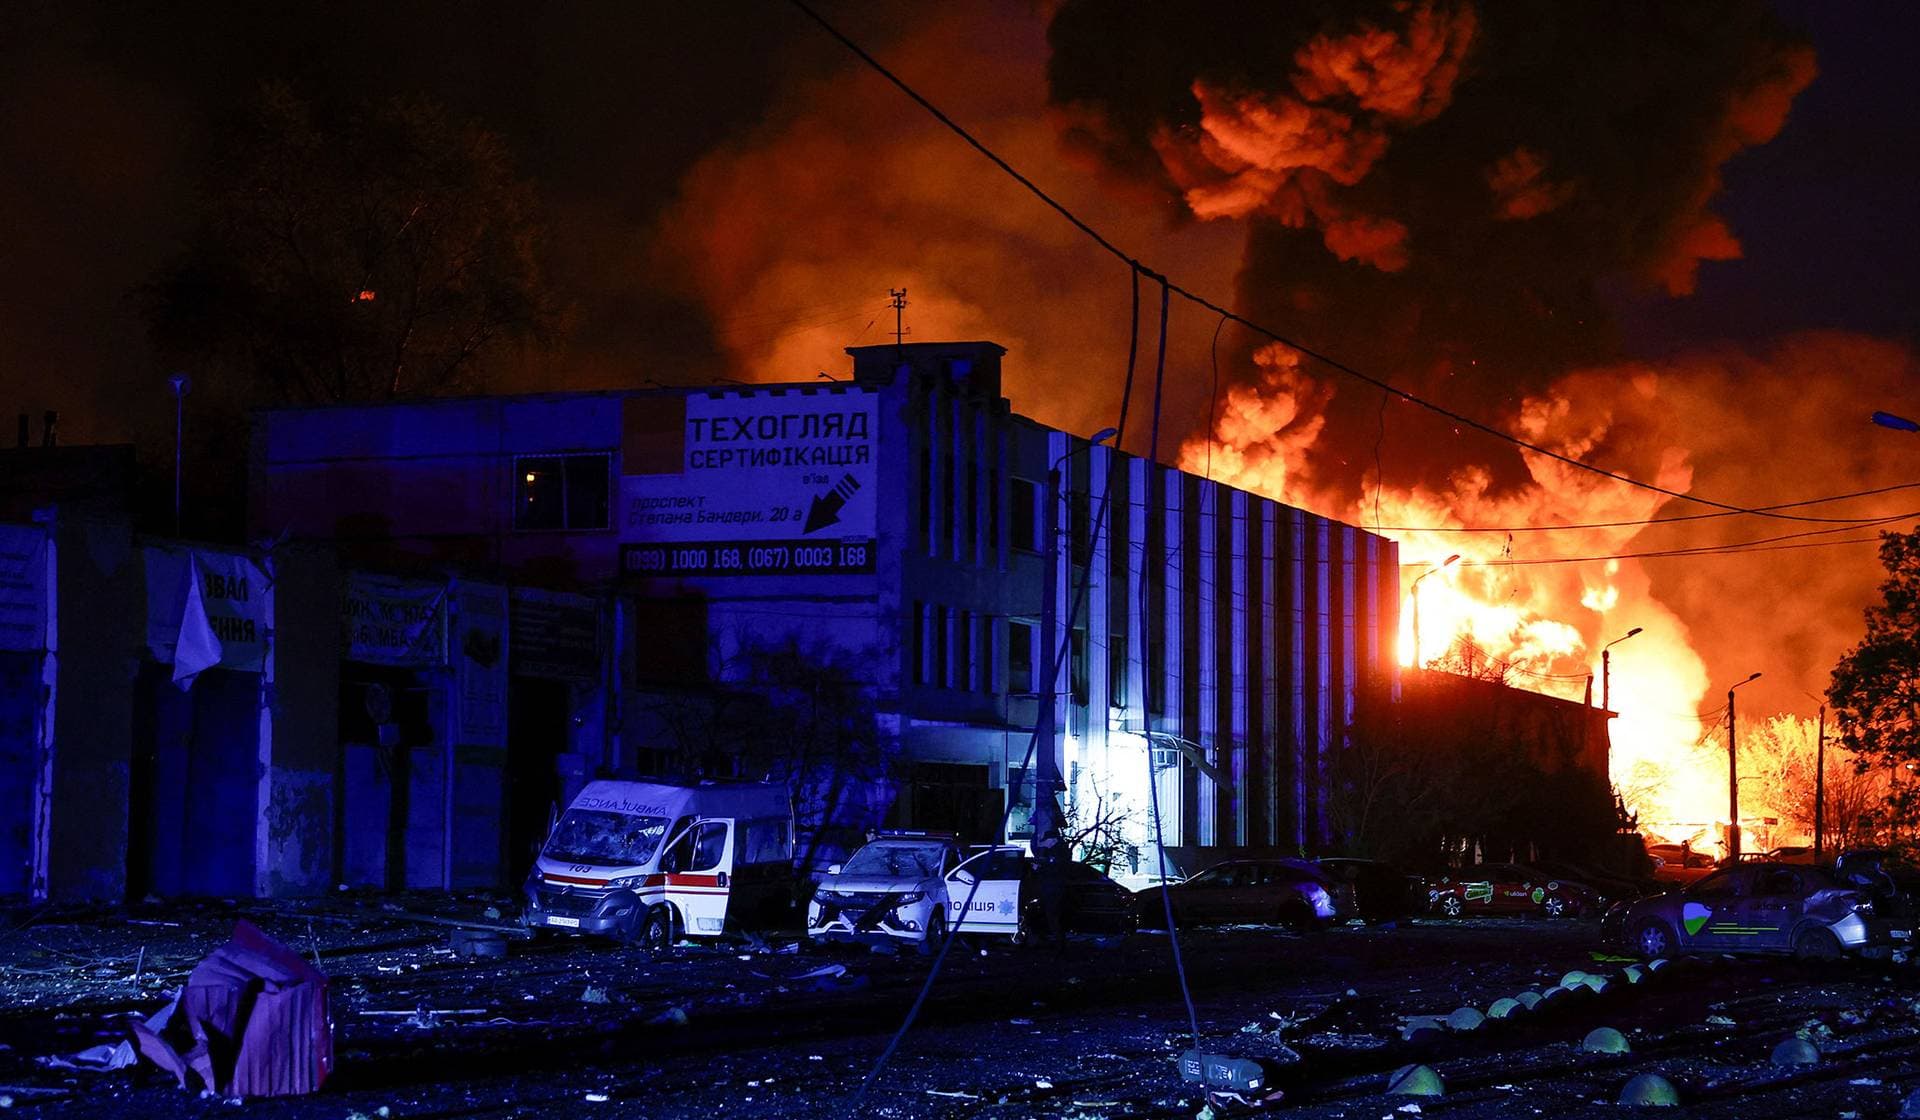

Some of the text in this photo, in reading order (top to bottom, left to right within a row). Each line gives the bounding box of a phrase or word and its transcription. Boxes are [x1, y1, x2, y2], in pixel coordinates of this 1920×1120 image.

[688, 411, 868, 442] ТЕХОГЛЯД
[690, 445, 870, 469] СЕРТИФІКАЦІЯ
[631, 496, 706, 511] проспект
[629, 511, 693, 525] Степана
[769, 507, 789, 522] 20
[671, 549, 707, 569] 1000
[713, 549, 743, 570] 168,
[748, 547, 789, 569] (067)
[794, 546, 832, 567] 0003
[838, 545, 866, 567] 168
[206, 573, 248, 602] ЗВАЛ
[568, 864, 592, 873] 103
[948, 901, 995, 912] ПОІЦІЯ
